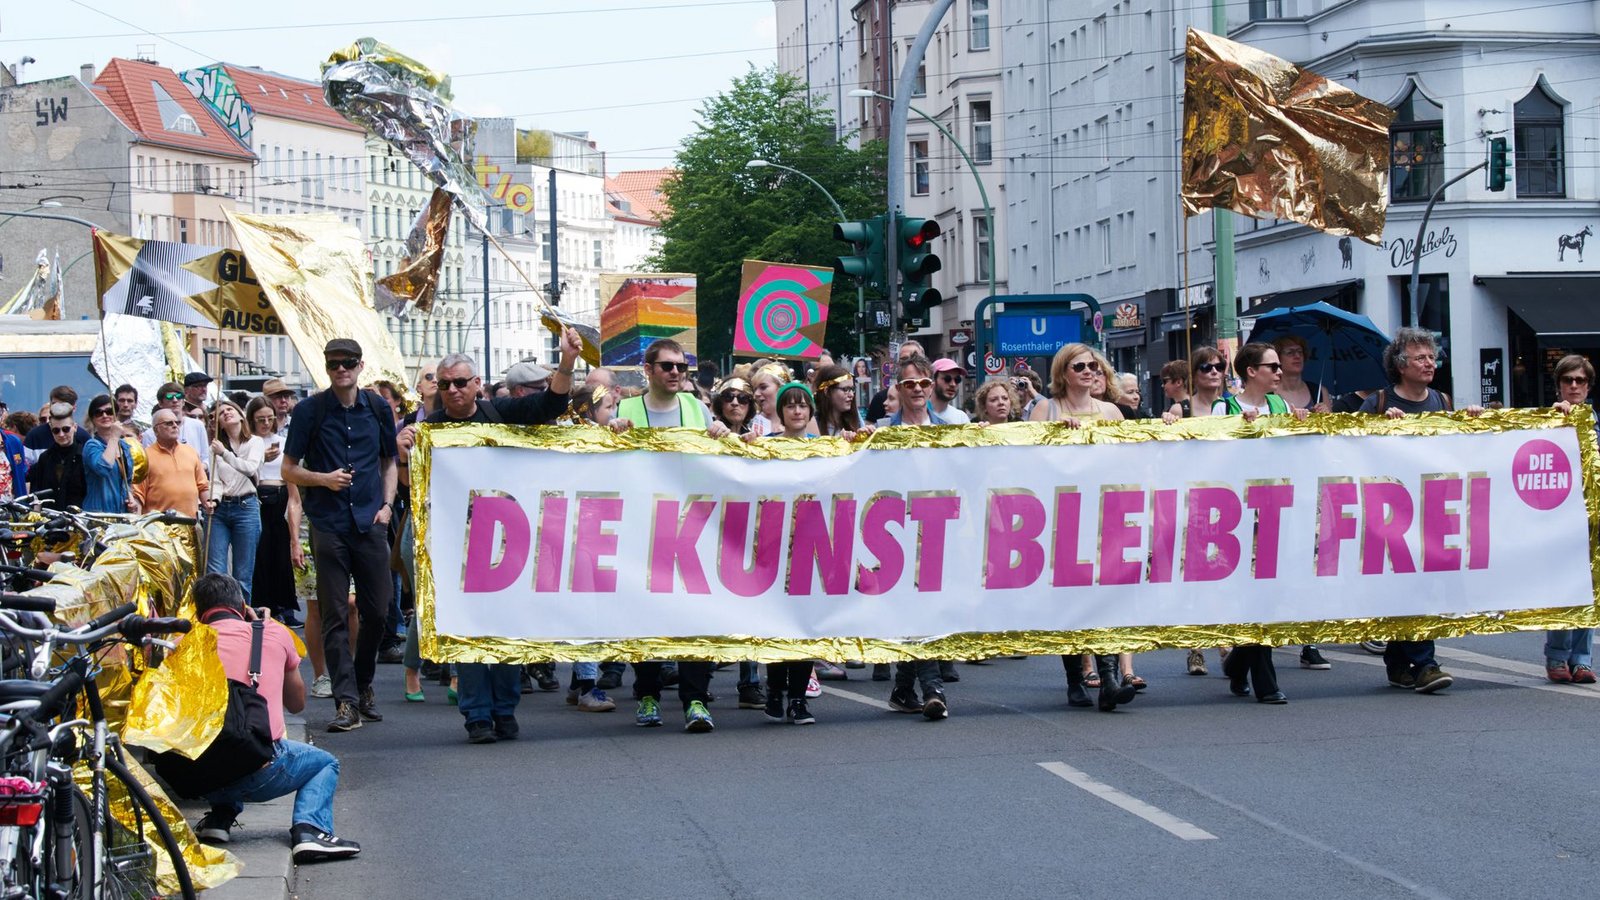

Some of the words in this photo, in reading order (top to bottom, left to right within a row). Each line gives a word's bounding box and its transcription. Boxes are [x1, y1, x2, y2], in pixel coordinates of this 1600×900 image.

[1389, 226, 1457, 269] Obrholz
[218, 252, 260, 286] GL
[1031, 318, 1047, 336] U
[1001, 342, 1053, 352] Rosenthaler
[987, 357, 1000, 369] 30
[1482, 378, 1492, 386] DAS
[1482, 386, 1498, 394] LEBEN
[1529, 453, 1554, 471] DIE
[1517, 472, 1569, 491] VIELEN
[460, 489, 623, 594] DIE
[645, 489, 961, 597] KUNST
[981, 477, 1295, 590] BLEIBT
[1313, 471, 1491, 577] FREI
